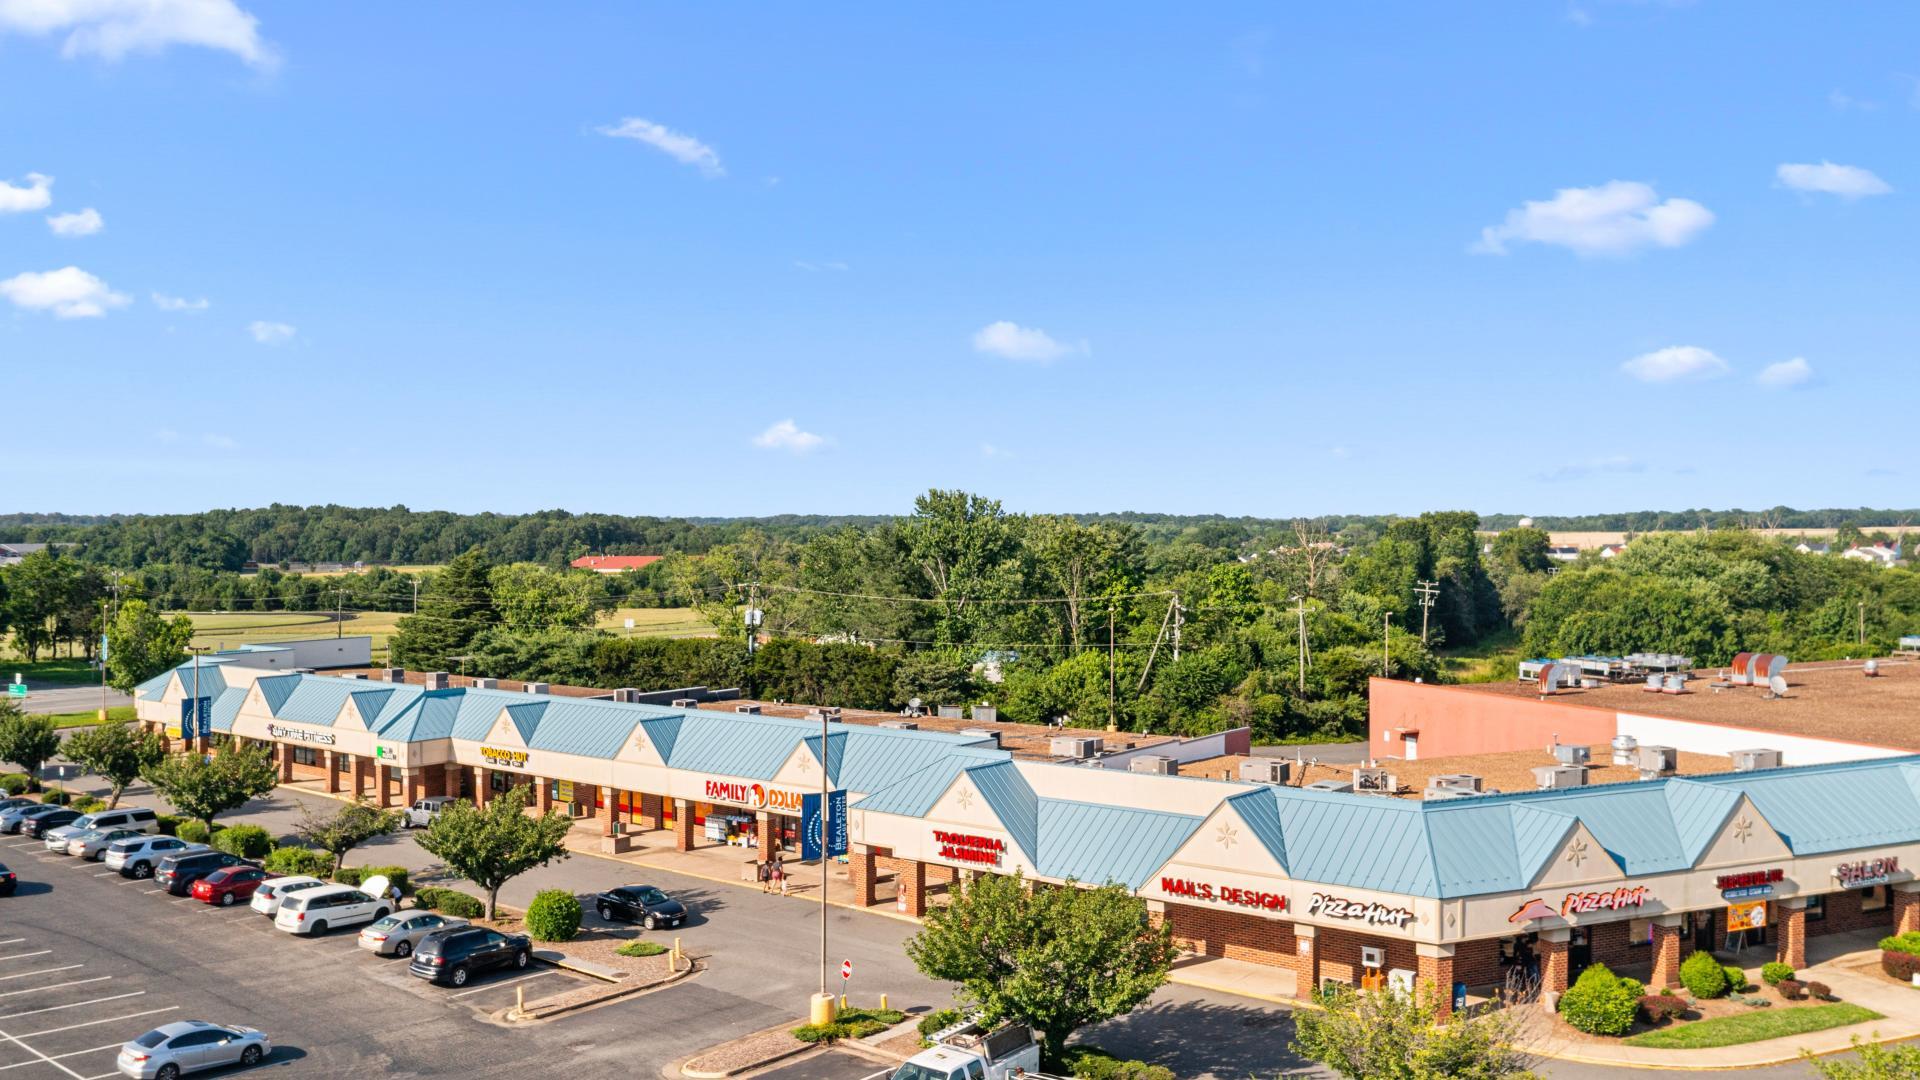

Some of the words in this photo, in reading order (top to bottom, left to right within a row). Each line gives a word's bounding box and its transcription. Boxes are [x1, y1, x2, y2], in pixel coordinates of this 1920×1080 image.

[480, 746, 512, 760] TOBACCO
[705, 780, 747, 801] FAMILY
[769, 789, 803, 809] DOLLA
[932, 830, 1004, 852] TAQUERIA
[1838, 856, 1898, 882] SALON
[1161, 877, 1213, 899] NAIL'S
[1220, 886, 1286, 910] DESIGN
